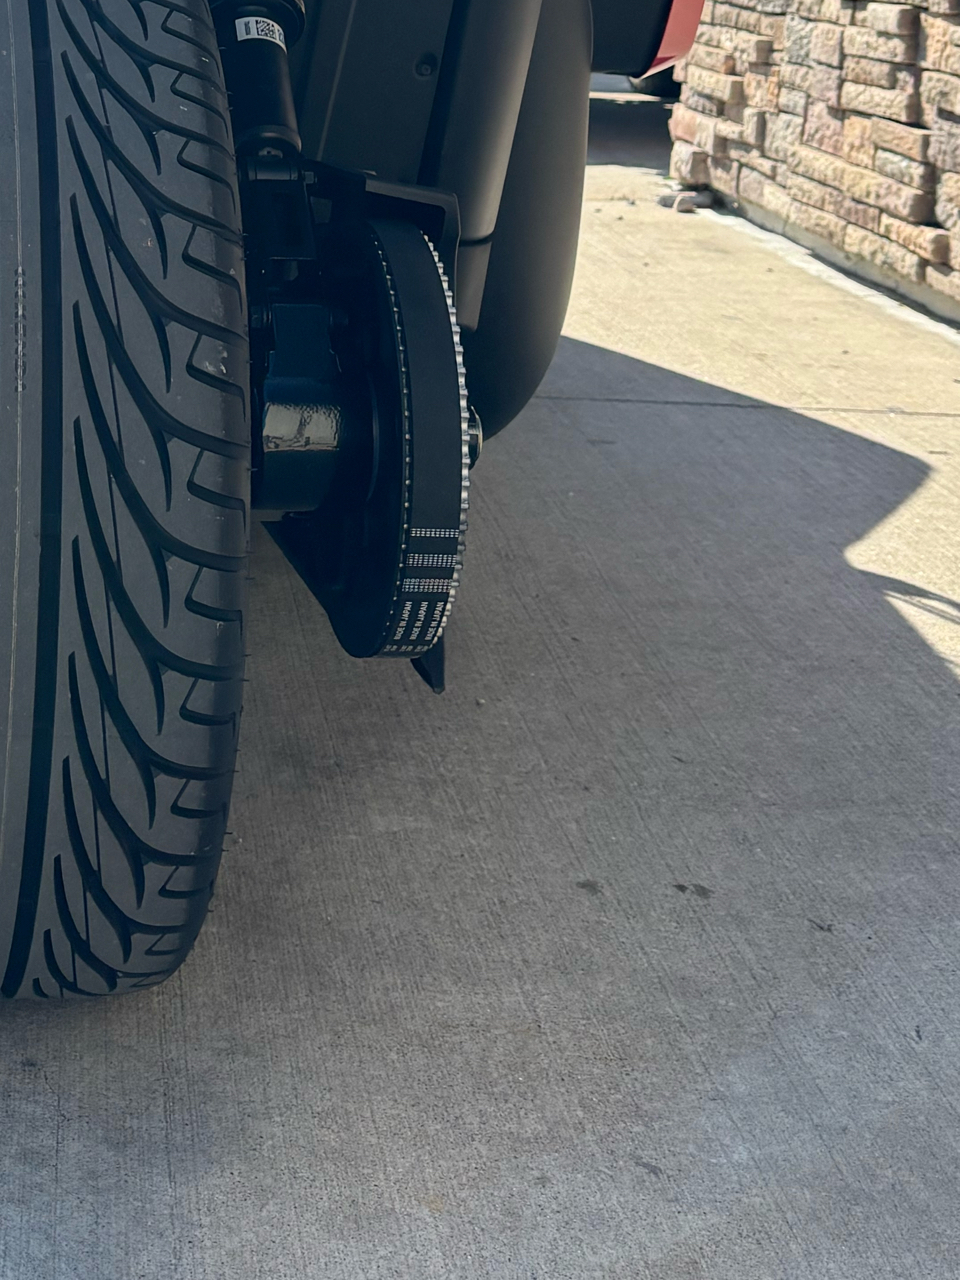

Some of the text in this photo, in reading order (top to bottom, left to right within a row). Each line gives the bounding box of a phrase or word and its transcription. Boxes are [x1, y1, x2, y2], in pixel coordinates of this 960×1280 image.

[14, 302, 27, 393] KENDA
[400, 601, 413, 620] JAPAN
[417, 601, 429, 620] JAPAN
[433, 601, 445, 620] JAPAN
